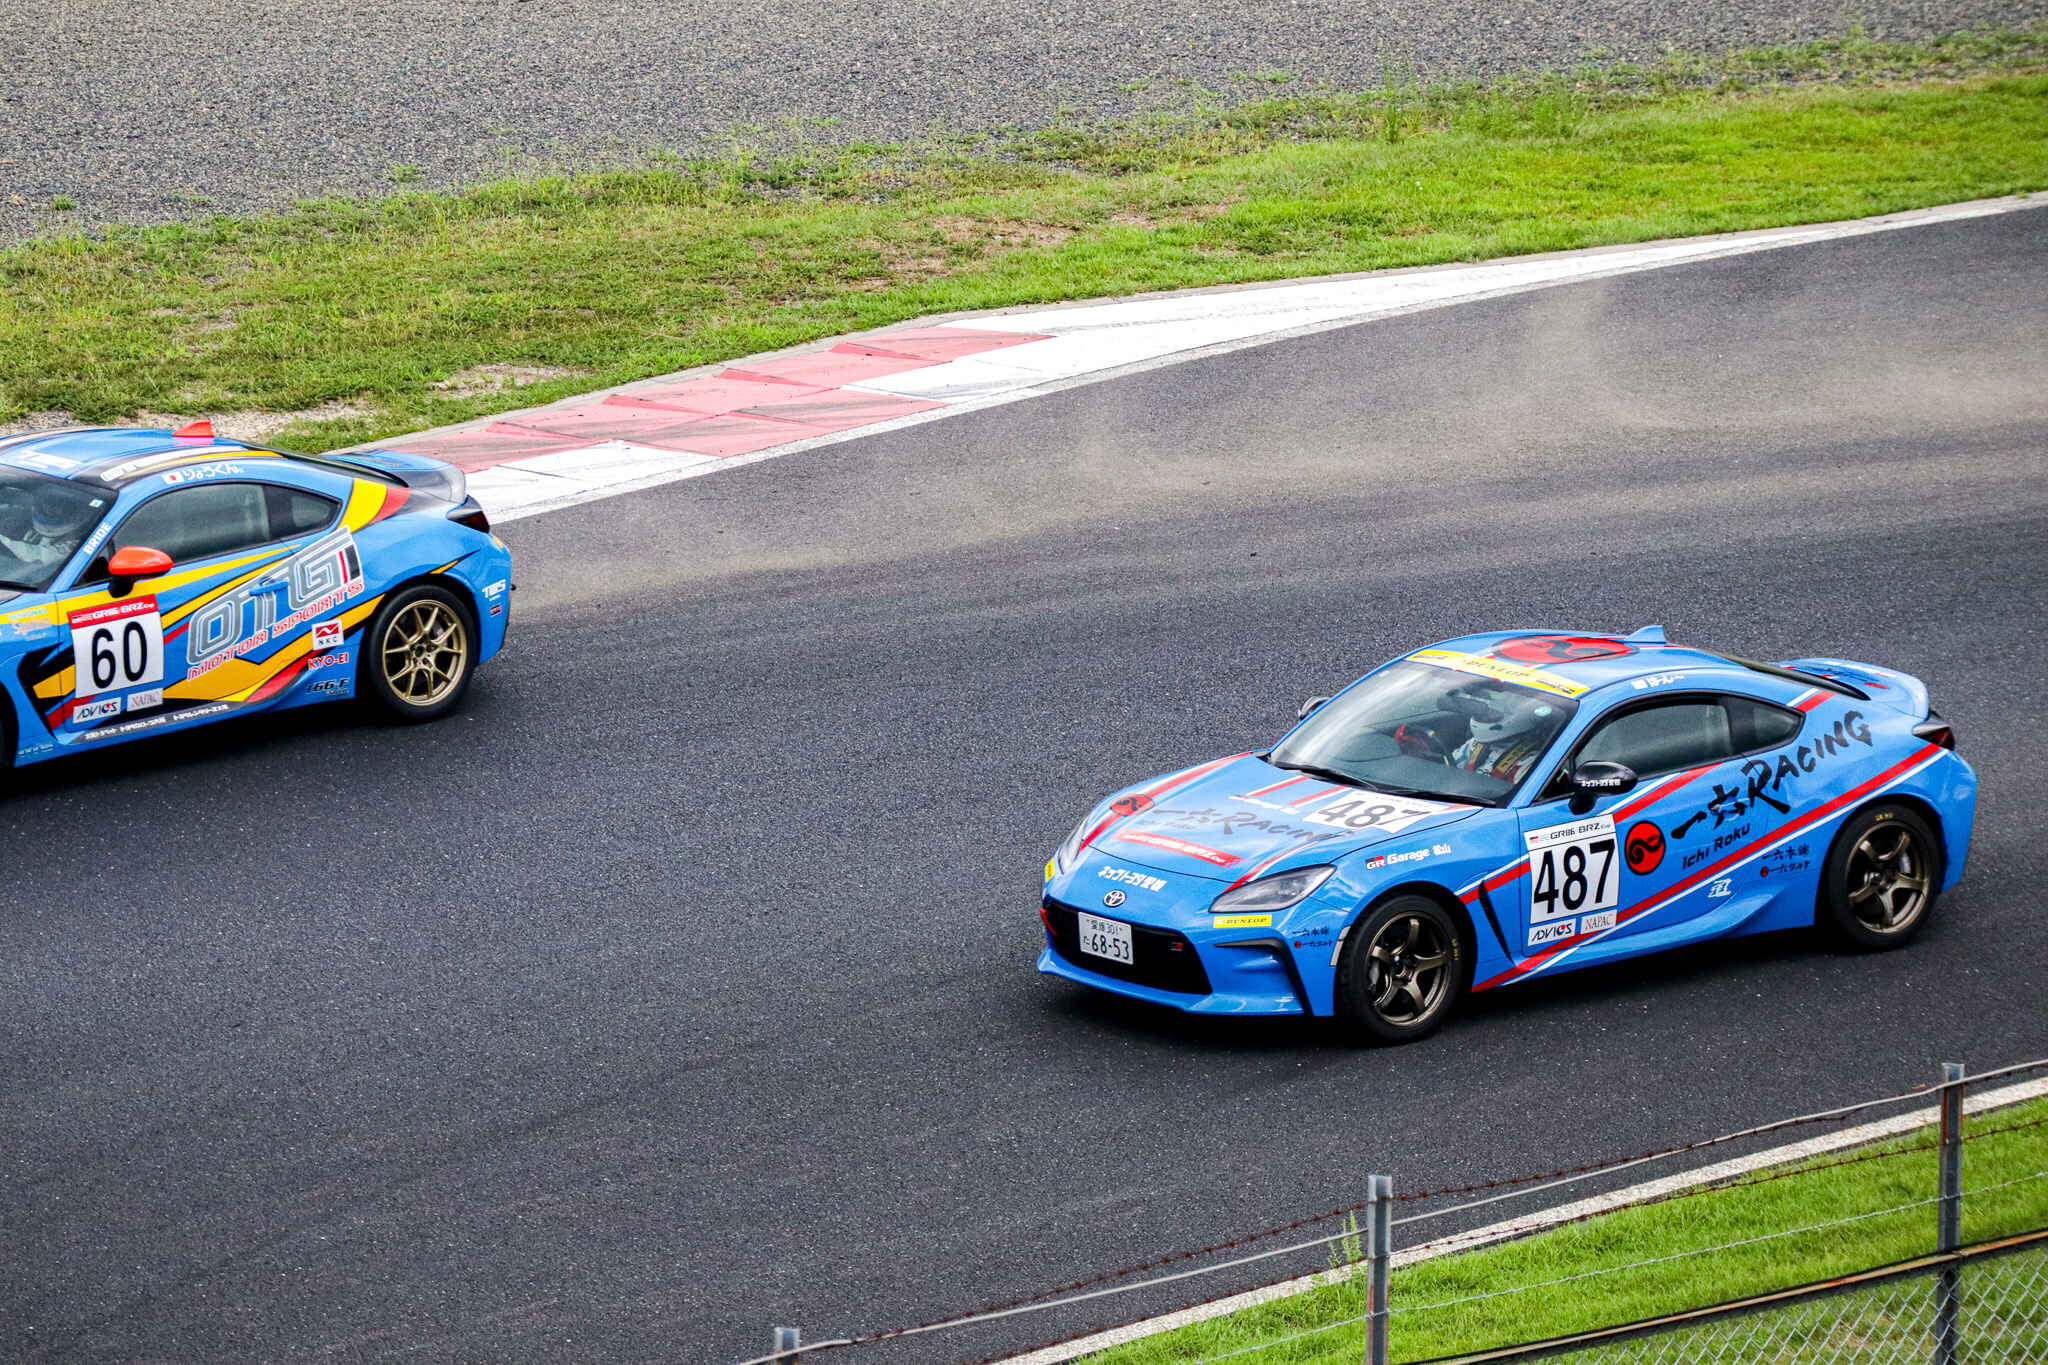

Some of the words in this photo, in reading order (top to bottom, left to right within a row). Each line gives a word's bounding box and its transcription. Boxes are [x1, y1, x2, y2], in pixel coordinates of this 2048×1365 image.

[83, 522, 112, 554] BRIDE
[91, 620, 148, 689] 60
[308, 652, 350, 671] KYO-EI
[77, 701, 118, 720] ADVICS
[1740, 710, 1873, 815] RACING
[1317, 799, 1432, 828] 487
[1387, 847, 1431, 865] Garage
[1533, 838, 1616, 914] 487
[1531, 922, 1573, 942] ADVICS
[1584, 914, 1611, 930] NAPAC
[1091, 933, 1130, 960] 68-53
